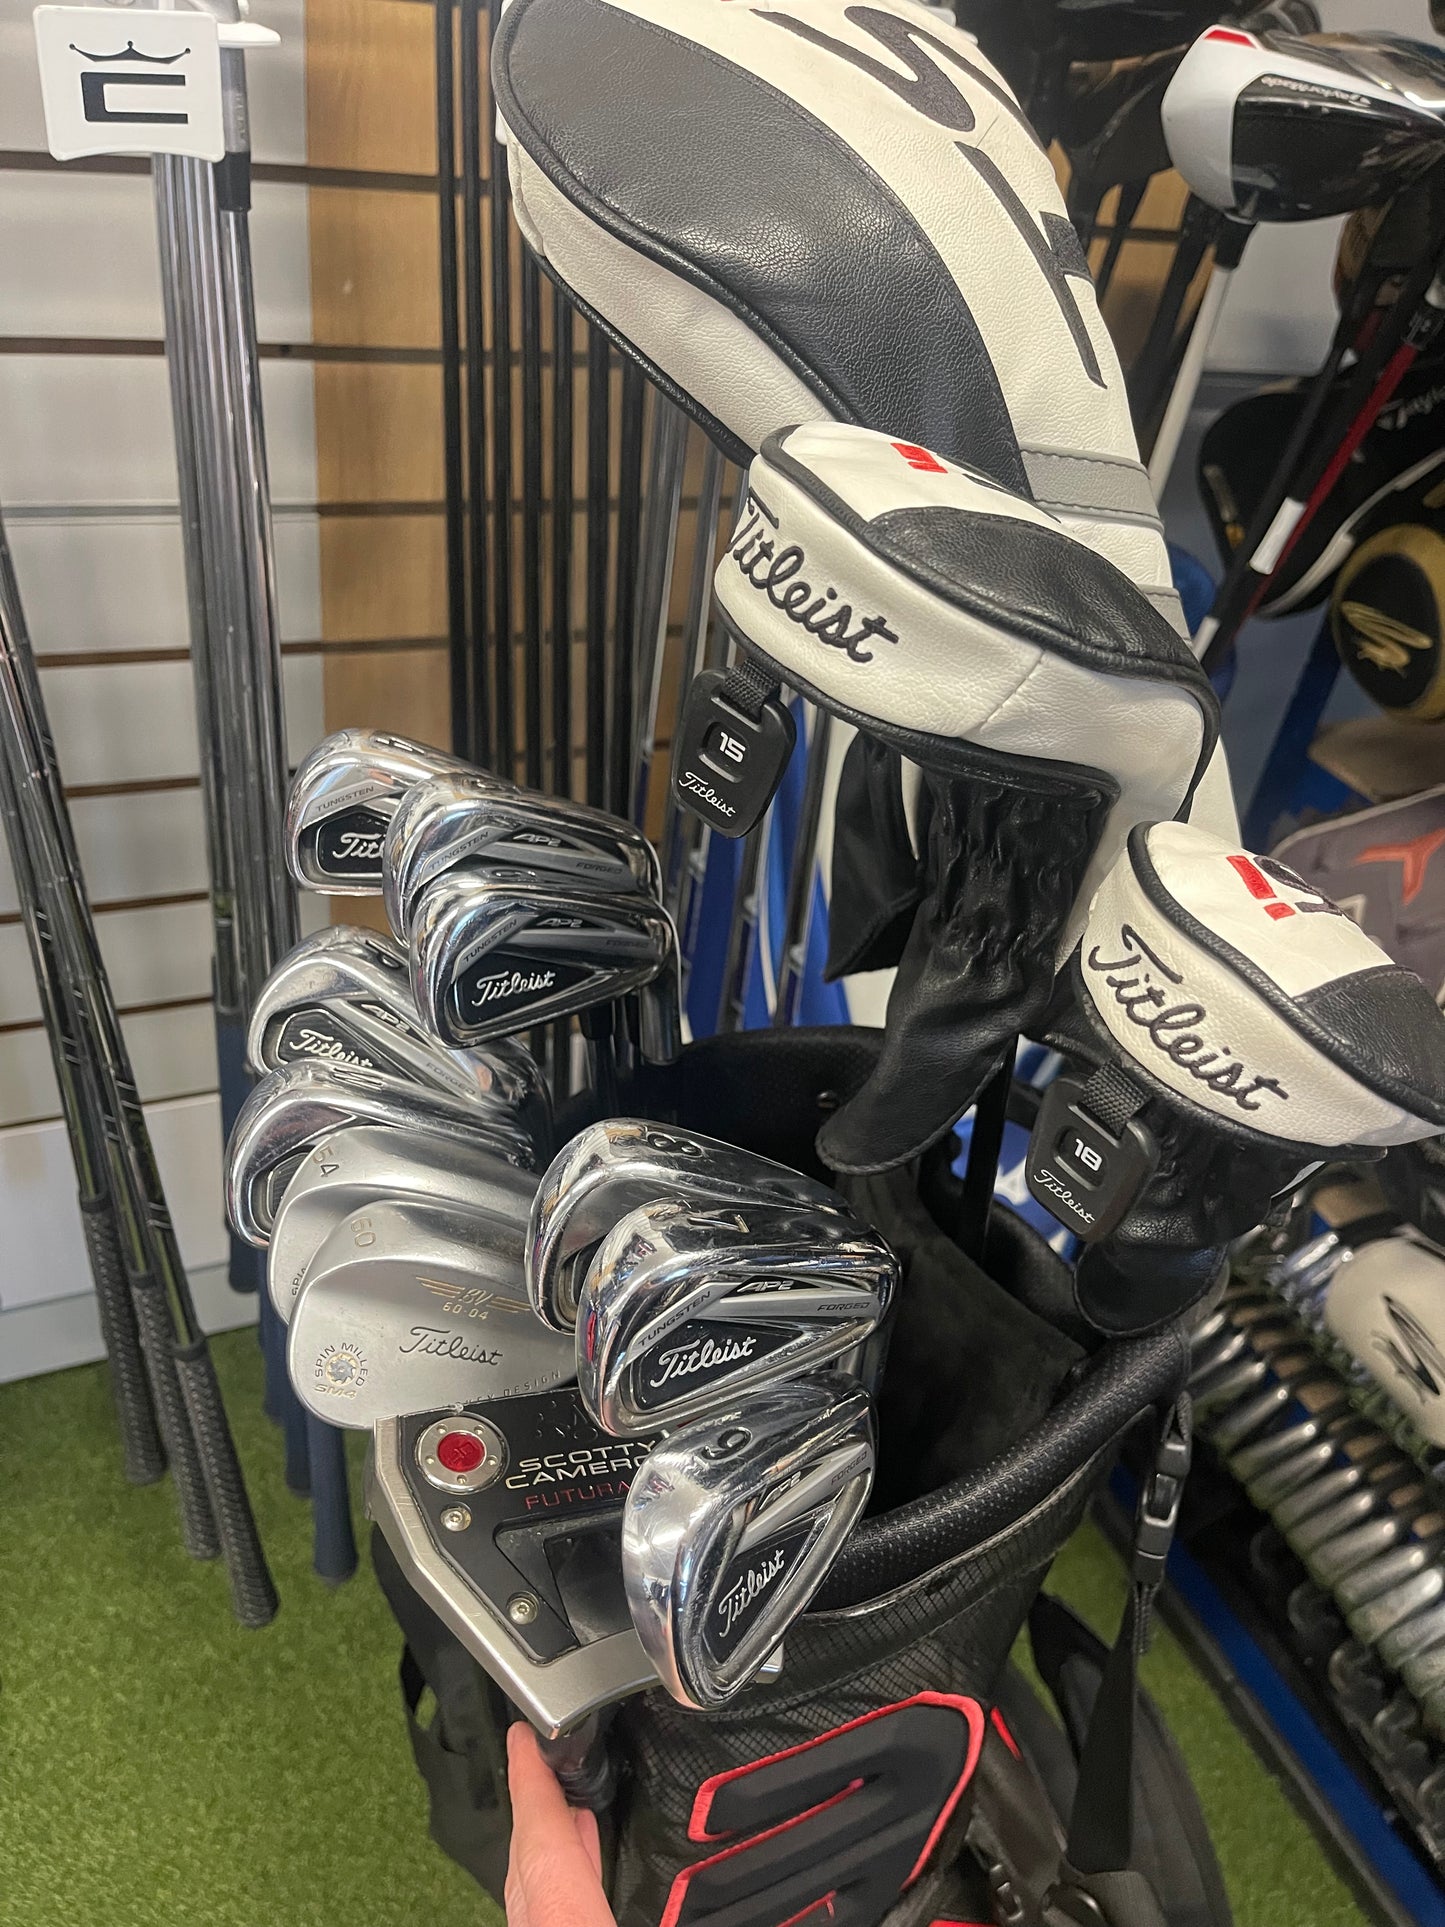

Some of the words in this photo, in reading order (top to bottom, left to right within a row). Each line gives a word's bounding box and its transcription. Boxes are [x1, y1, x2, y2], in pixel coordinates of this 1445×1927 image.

[726, 486, 900, 663] Titleist
[719, 731, 747, 763] 15
[316, 785, 375, 812] TUNGSTEN
[678, 771, 737, 818] Titleist
[428, 830, 490, 871] TUNGSTEN
[512, 833, 563, 848] AP2
[575, 861, 624, 875] FORGED
[463, 918, 518, 963] TUNGSTEN
[535, 917, 584, 929] AP2
[471, 970, 556, 1007] Titleist
[360, 1003, 411, 1034] AP2
[1088, 924, 1290, 1111] Titleist
[289, 1029, 374, 1068] Titleist
[425, 1061, 477, 1096] FORGED
[645, 1126, 704, 1158] 8
[1074, 1138, 1103, 1172] 18
[312, 1145, 340, 1178] 54
[1033, 1169, 1096, 1224] Titleist
[350, 1216, 377, 1248] 60
[736, 1280, 794, 1292] AP2
[636, 1290, 711, 1347] TUNGSTEN
[817, 1301, 871, 1312] FORGED
[399, 1326, 503, 1366] Titleist
[650, 1336, 757, 1389] Titleist
[314, 1345, 336, 1378] SPIN
[341, 1342, 369, 1387] MILLED
[313, 1382, 358, 1400] SM4
[503, 1369, 561, 1397] DESIGN
[518, 1440, 656, 1473] SCOTTY
[701, 1427, 752, 1461] 9
[504, 1453, 648, 1491] CAMER
[830, 1451, 868, 1487] FORGED
[718, 1549, 785, 1638] Titleist
